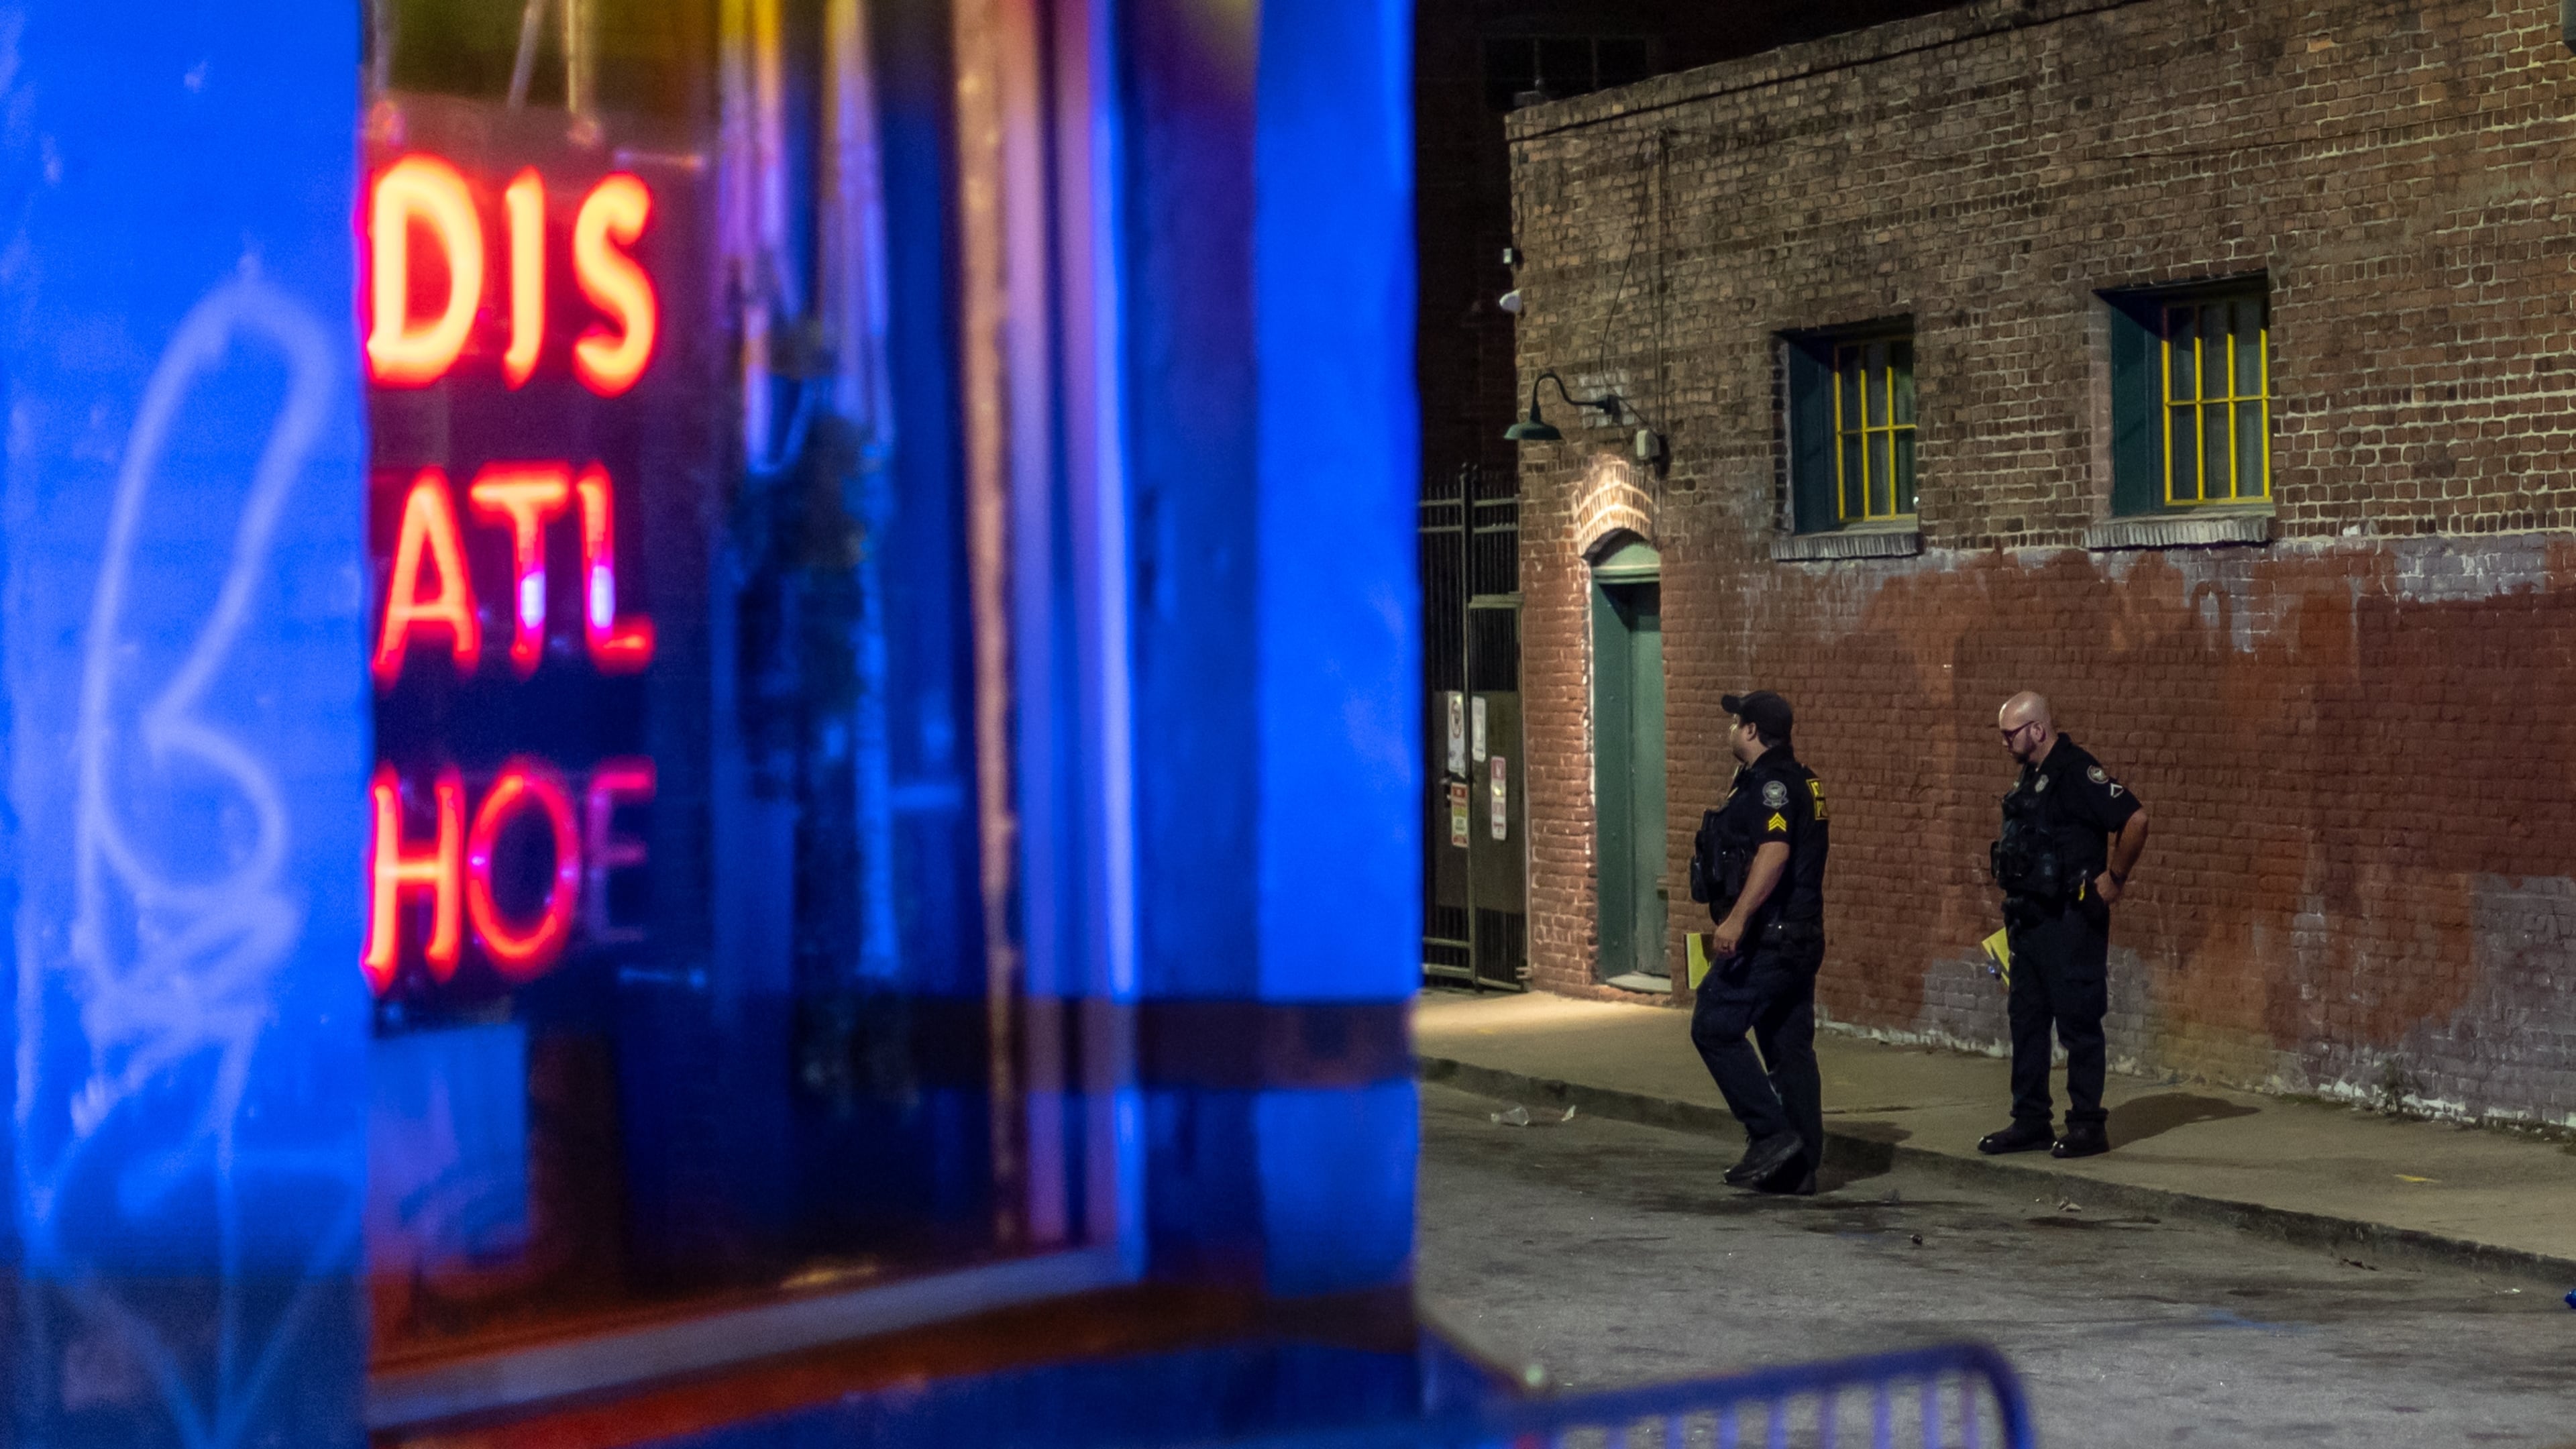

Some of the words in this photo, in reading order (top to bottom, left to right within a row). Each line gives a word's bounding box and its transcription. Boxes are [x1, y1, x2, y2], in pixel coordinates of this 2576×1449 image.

[368, 157, 655, 393] DIS
[373, 463, 653, 688] ATL
[362, 761, 654, 986] HOE
